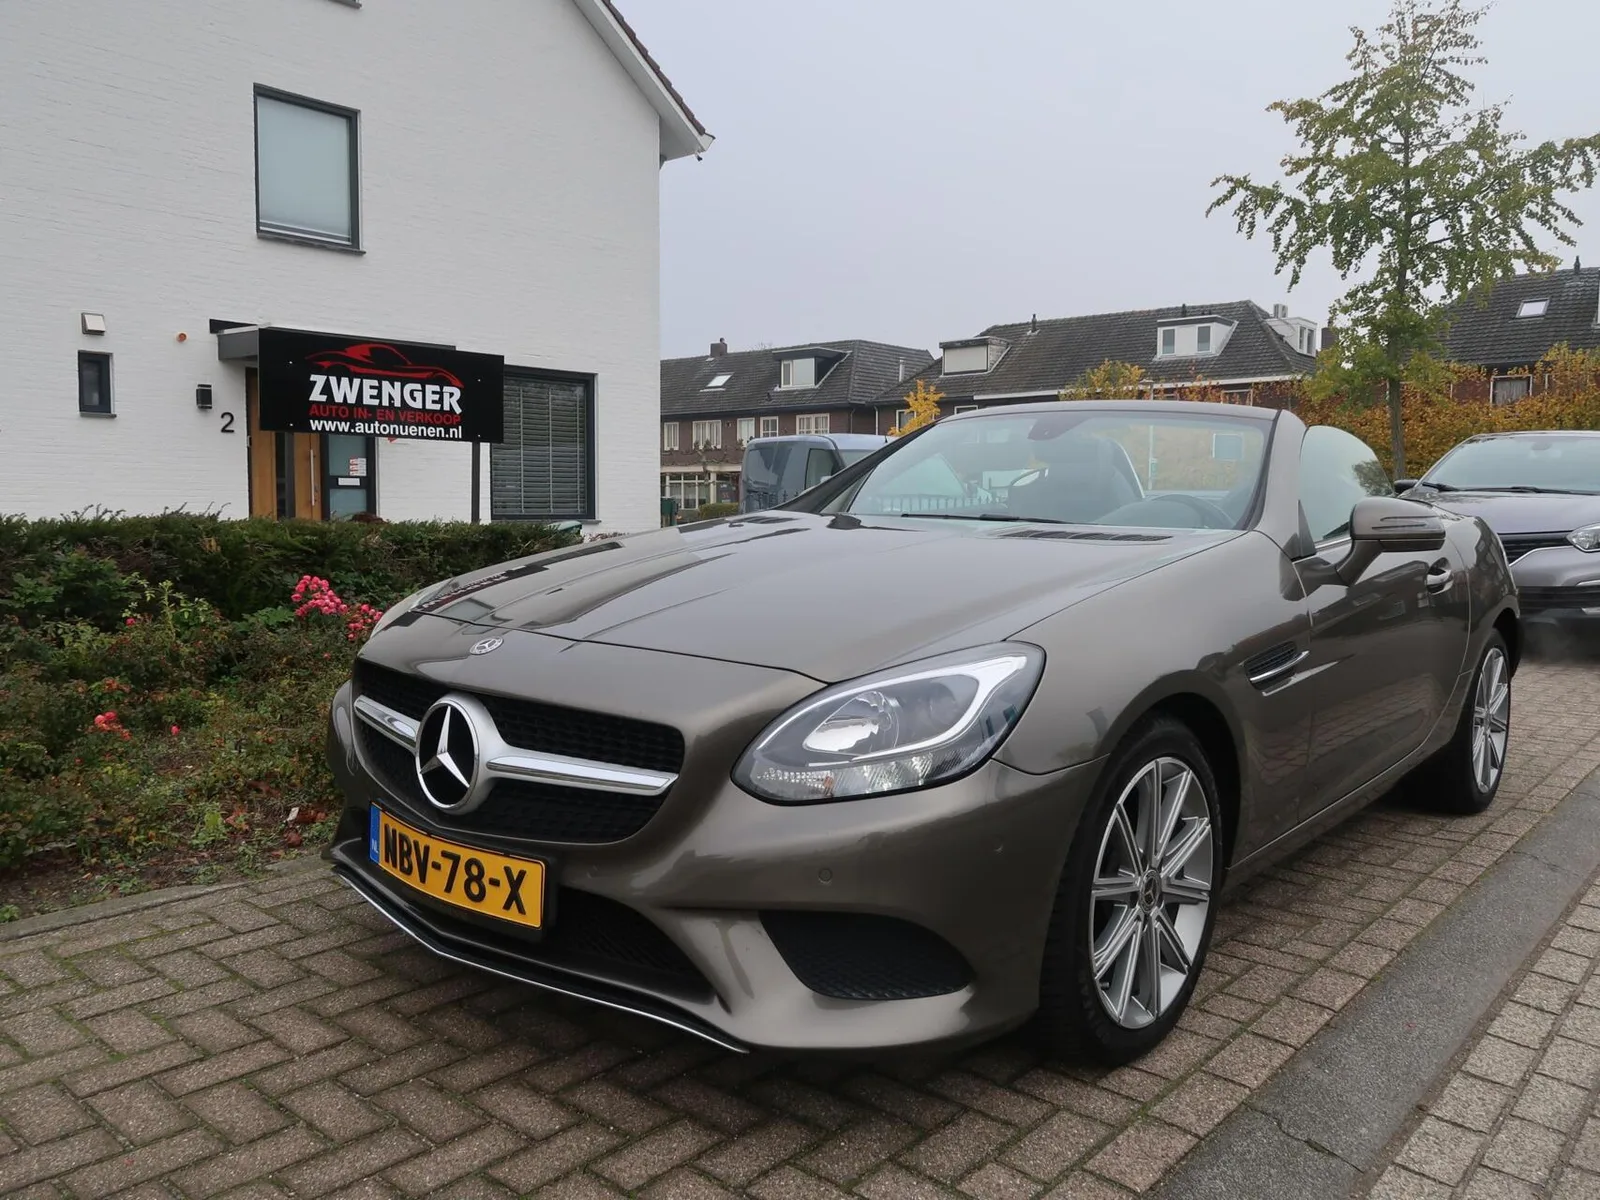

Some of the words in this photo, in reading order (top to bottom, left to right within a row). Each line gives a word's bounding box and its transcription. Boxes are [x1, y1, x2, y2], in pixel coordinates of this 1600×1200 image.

[308, 374, 463, 415] ZWENGER
[221, 411, 235, 433] 2
[309, 404, 349, 418] AUTO
[353, 409, 373, 419] IN-
[376, 409, 395, 421] EN
[399, 410, 462, 426] VERKOOP
[310, 419, 462, 439] www.autonuenen.nl
[371, 838, 379, 854] NL
[384, 823, 527, 915] NBV-78-X
